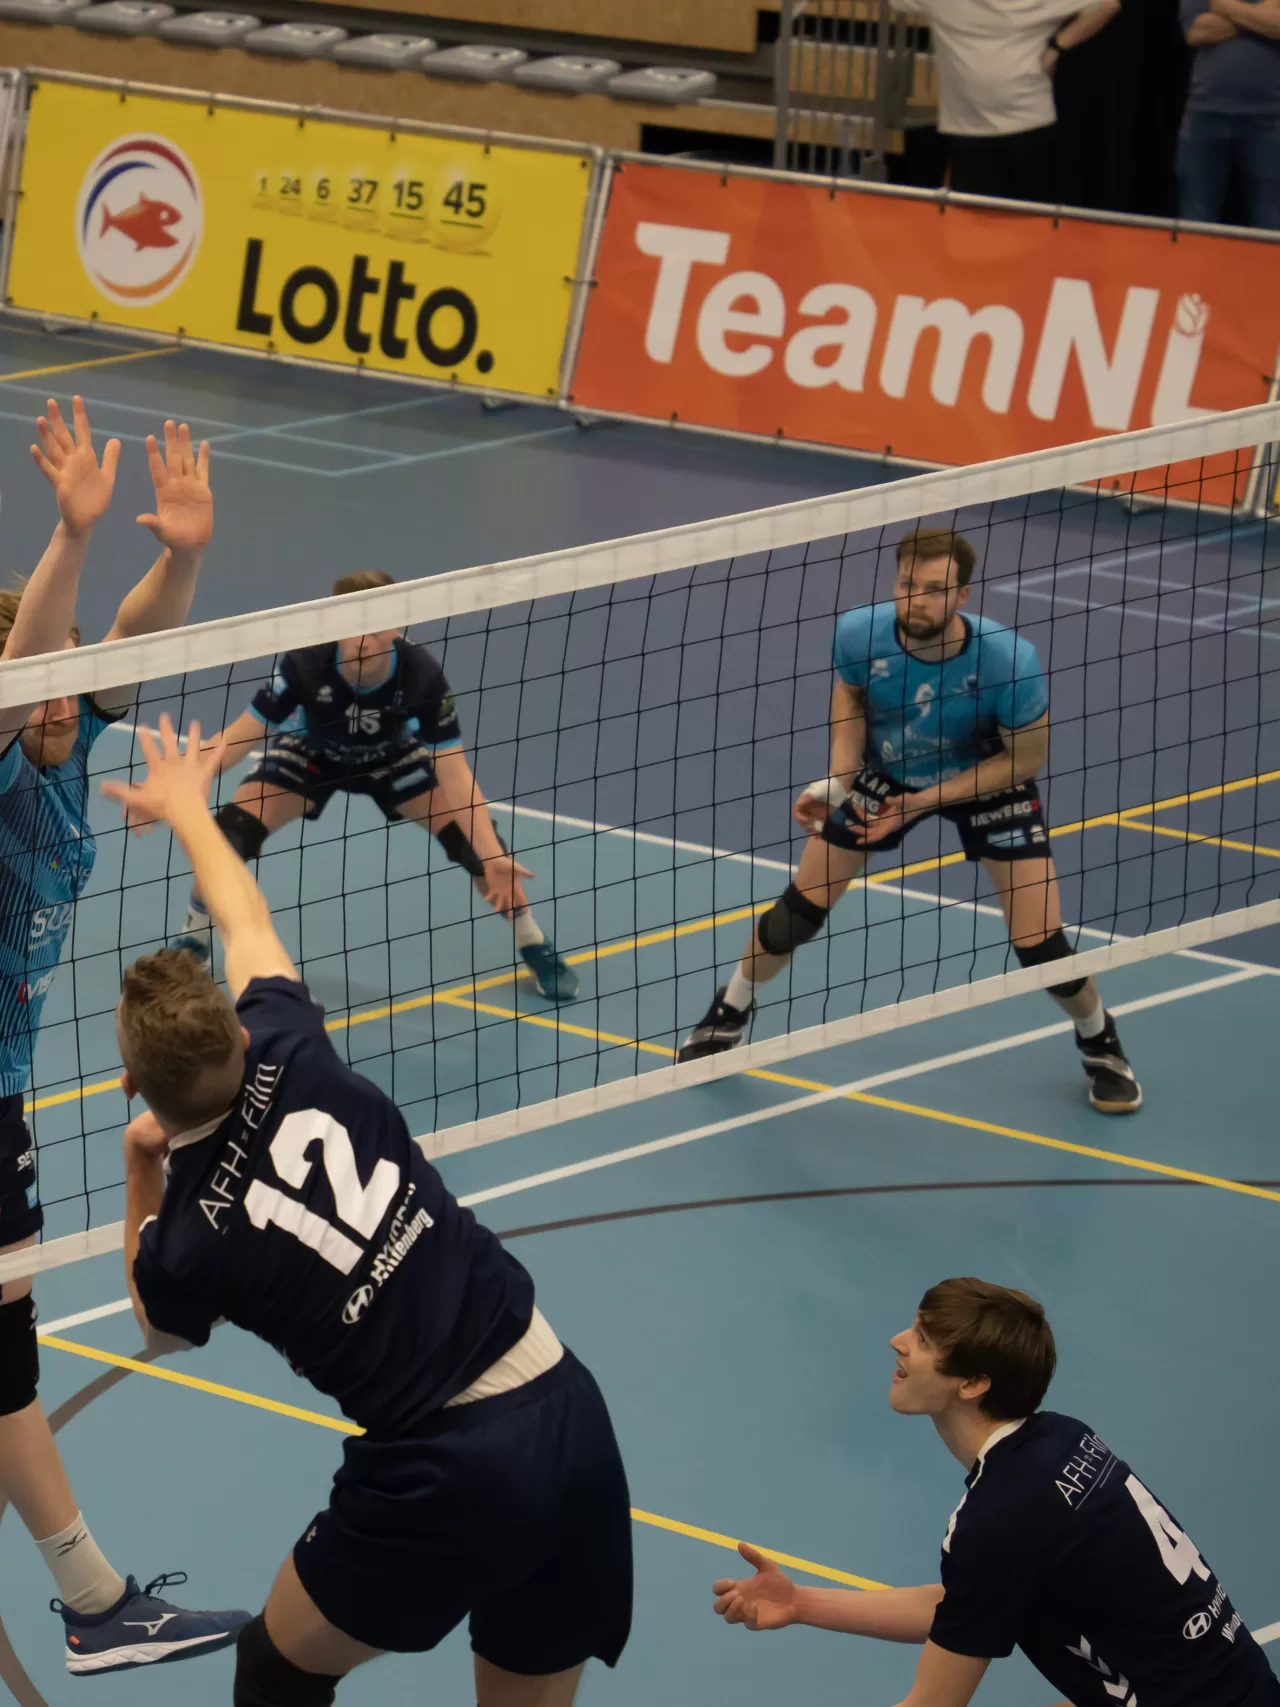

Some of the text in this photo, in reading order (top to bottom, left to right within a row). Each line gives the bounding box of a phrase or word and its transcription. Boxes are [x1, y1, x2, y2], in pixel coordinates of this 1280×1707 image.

[259, 177, 488, 218] 1 24 6 37 15 45
[236, 237, 494, 374] Lotto.
[635, 221, 1228, 433] TeamNL
[345, 703, 381, 735] 15
[244, 1108, 400, 1276] 12
[1125, 1473, 1211, 1586] 4
